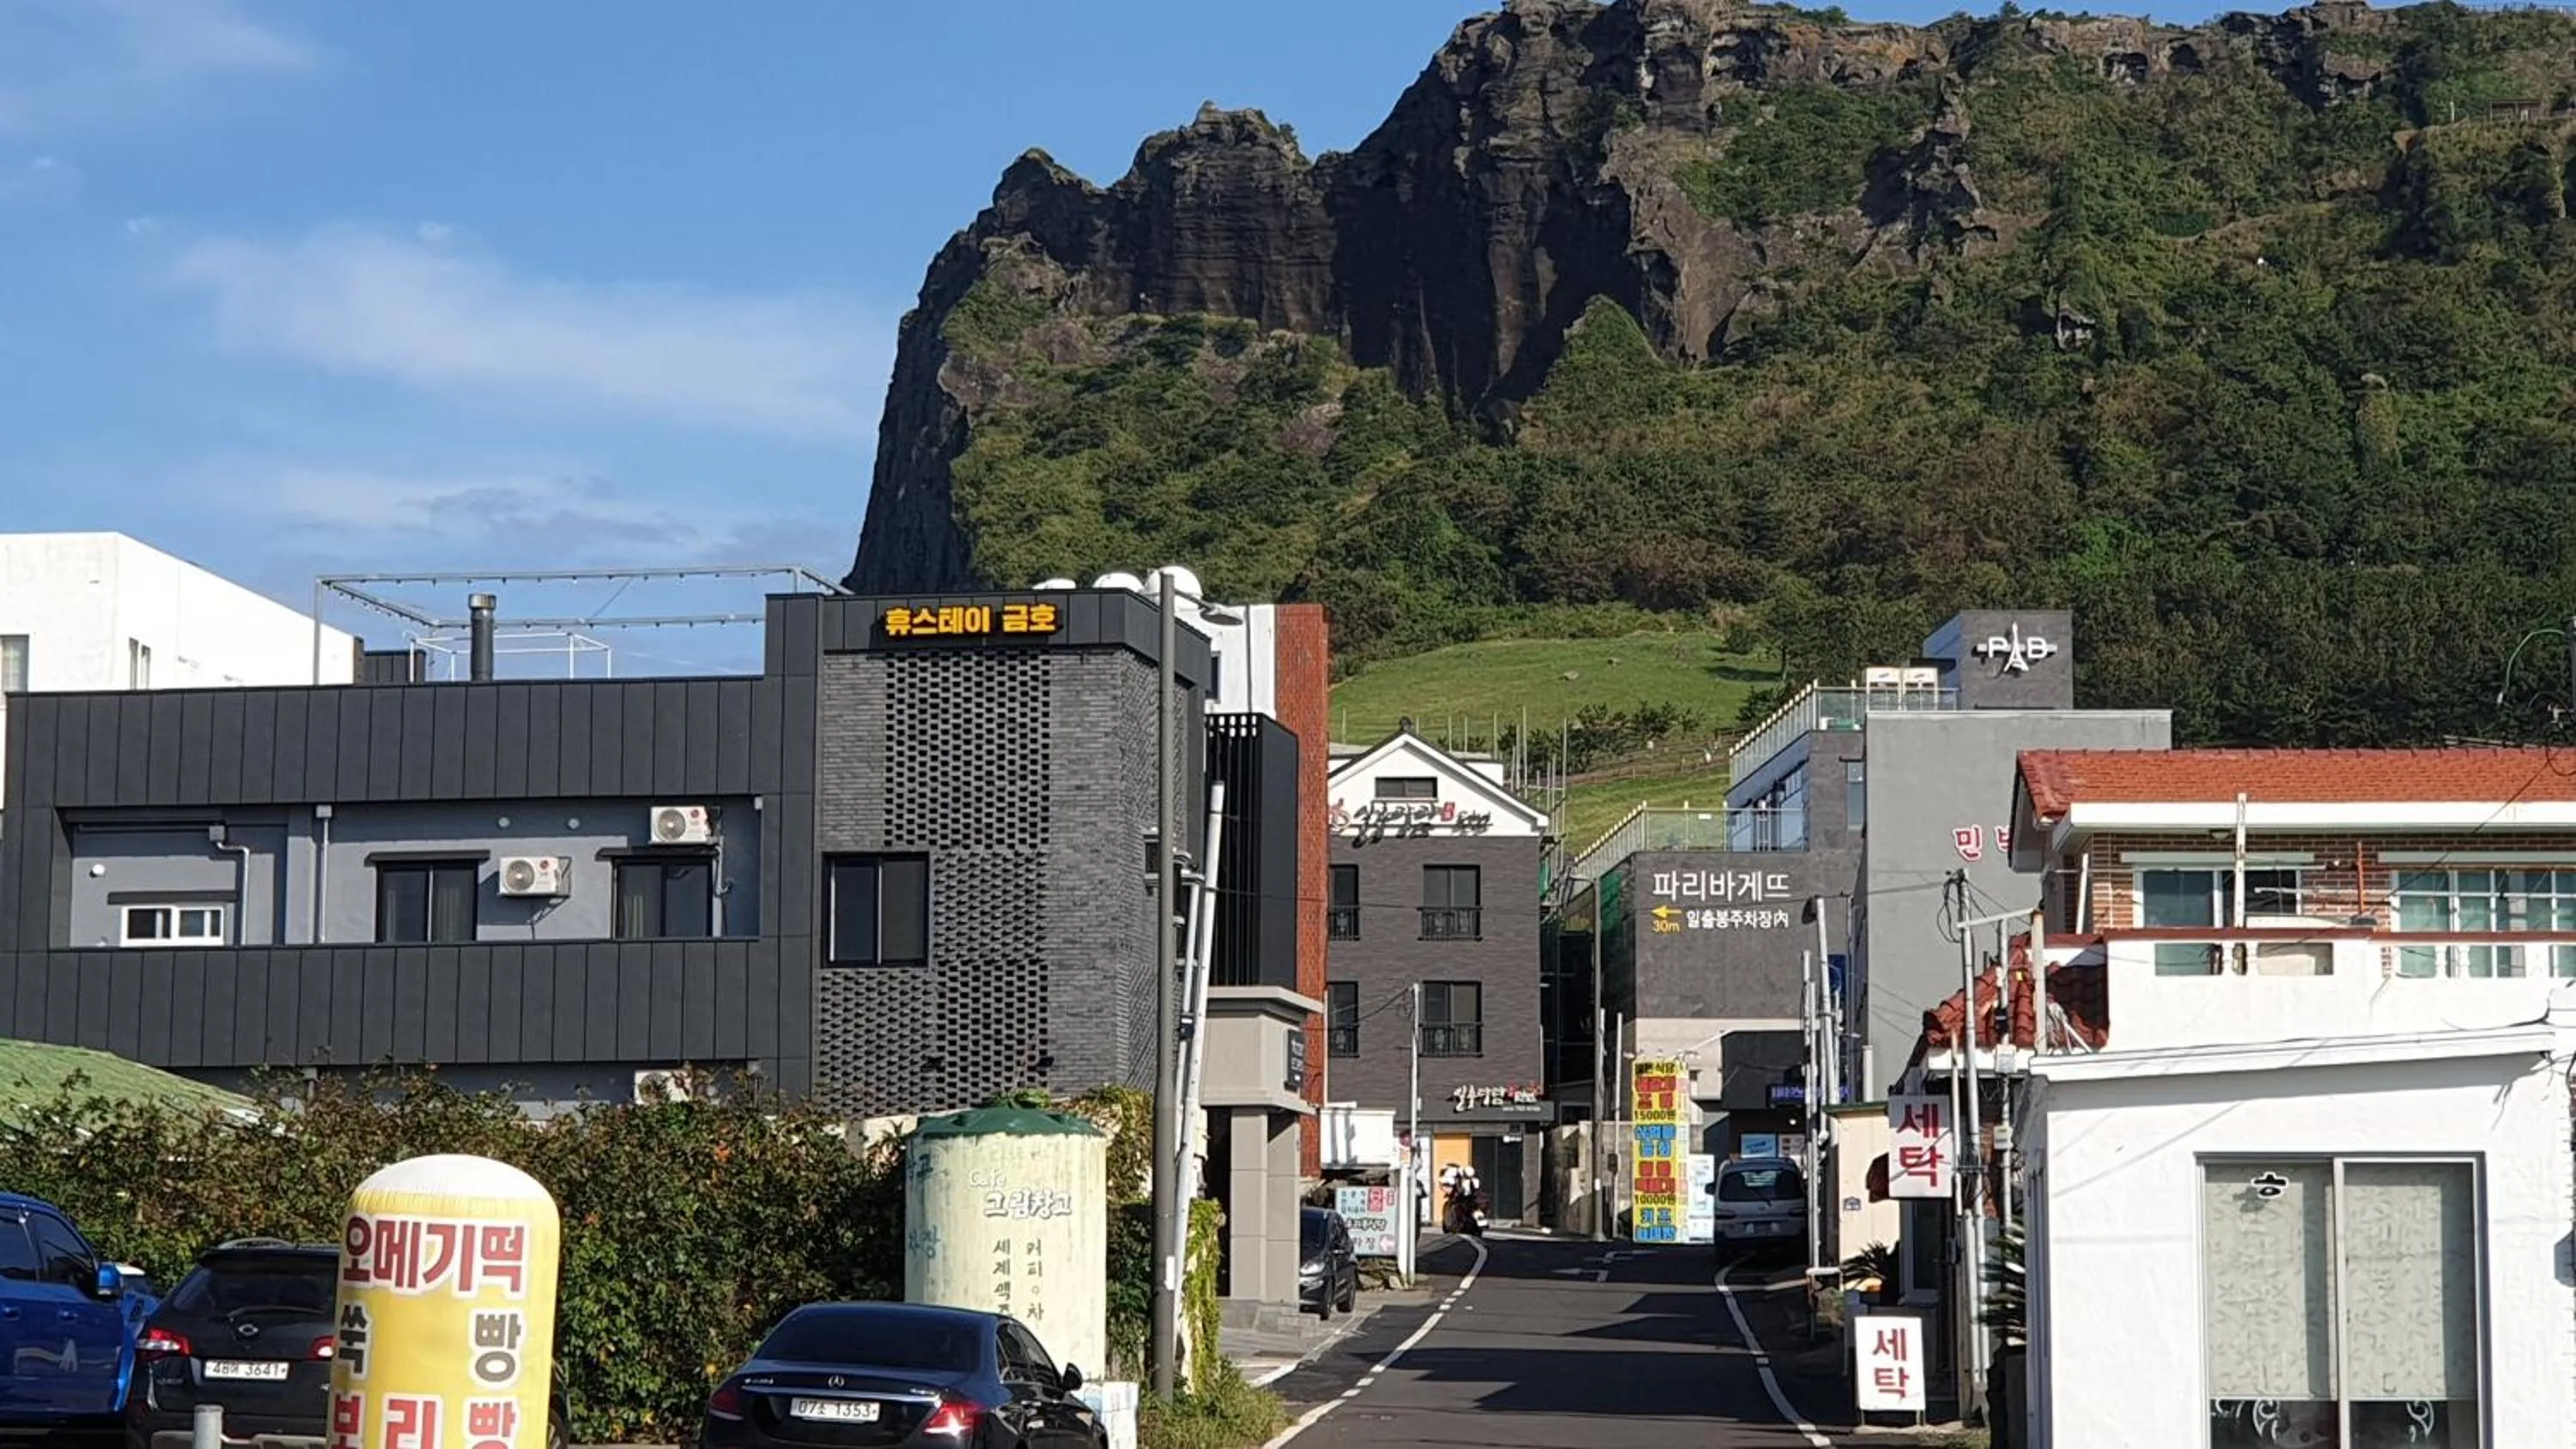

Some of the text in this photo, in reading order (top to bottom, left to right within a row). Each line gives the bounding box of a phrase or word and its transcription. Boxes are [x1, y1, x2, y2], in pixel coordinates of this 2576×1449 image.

[885, 603, 1056, 636] 휴스테이 금호
[1652, 870, 1793, 902] 파리바게뜨
[1652, 919, 1680, 933] 30m
[1896, 1104, 1944, 1187] 세탁
[969, 1168, 1007, 1188] Cafe
[984, 1182, 1072, 1220] 그림창고
[343, 1216, 525, 1293] 오메기떡
[1872, 1327, 1910, 1398] 세탁
[835, 1401, 872, 1418] 1353
